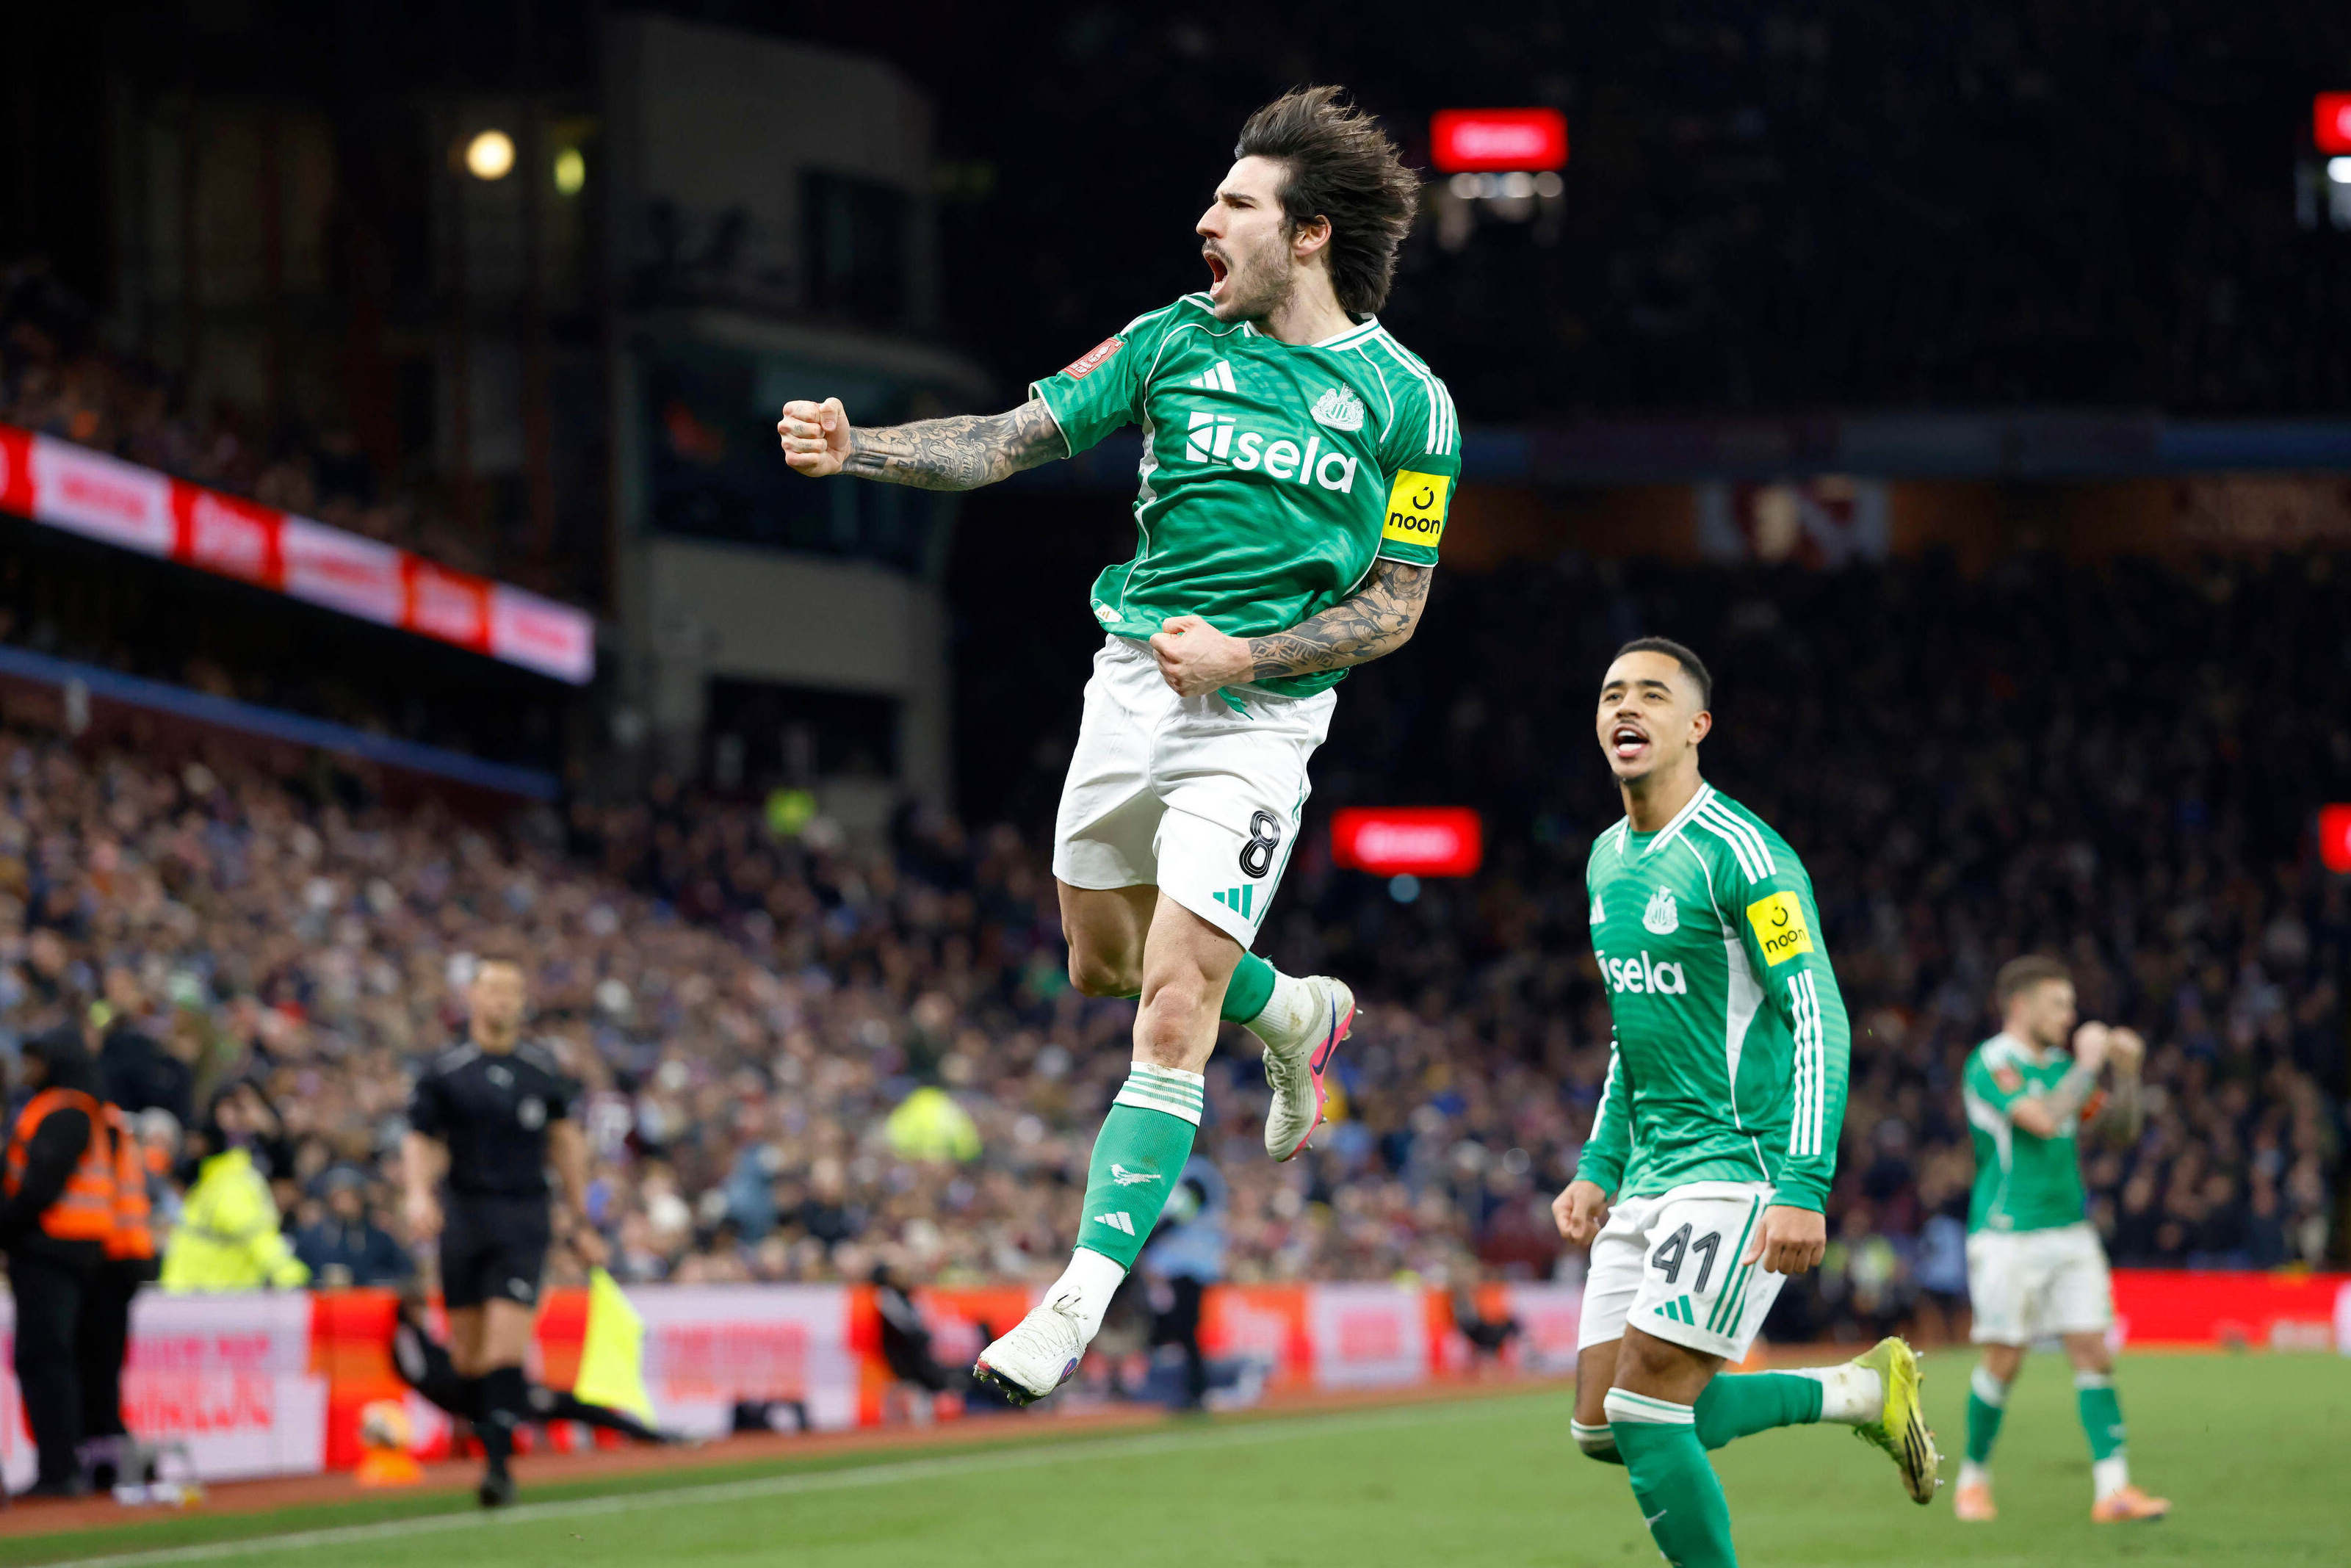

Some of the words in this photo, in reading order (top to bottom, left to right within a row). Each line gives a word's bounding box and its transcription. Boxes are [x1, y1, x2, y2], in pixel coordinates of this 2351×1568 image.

[1232, 432, 1358, 494] sela
[1389, 512, 1440, 534] noon
[1239, 810, 1281, 878] 8
[1766, 929, 1807, 953] noon
[1608, 950, 1687, 994] sela
[1652, 1222, 1721, 1294] 41
